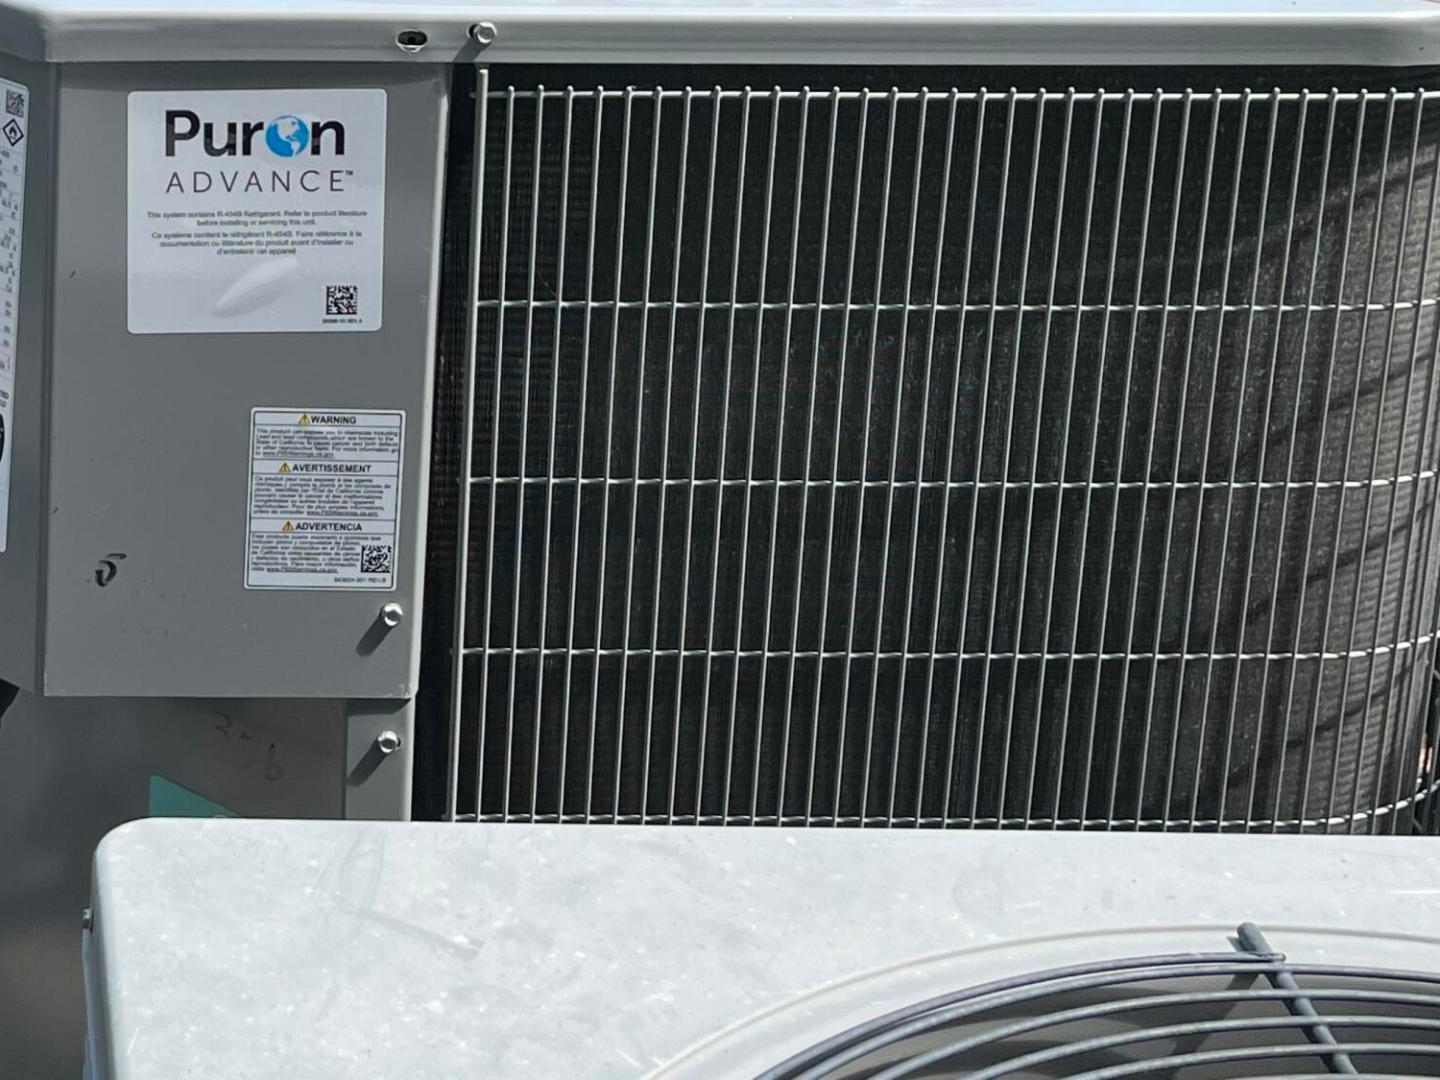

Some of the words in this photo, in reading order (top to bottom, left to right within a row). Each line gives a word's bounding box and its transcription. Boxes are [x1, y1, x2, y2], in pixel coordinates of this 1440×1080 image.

[165, 109, 345, 157] Puron
[311, 415, 357, 424] WARNING
[292, 464, 372, 473] AVERTISSEMENT
[295, 522, 362, 531] ADVERTENCIA
